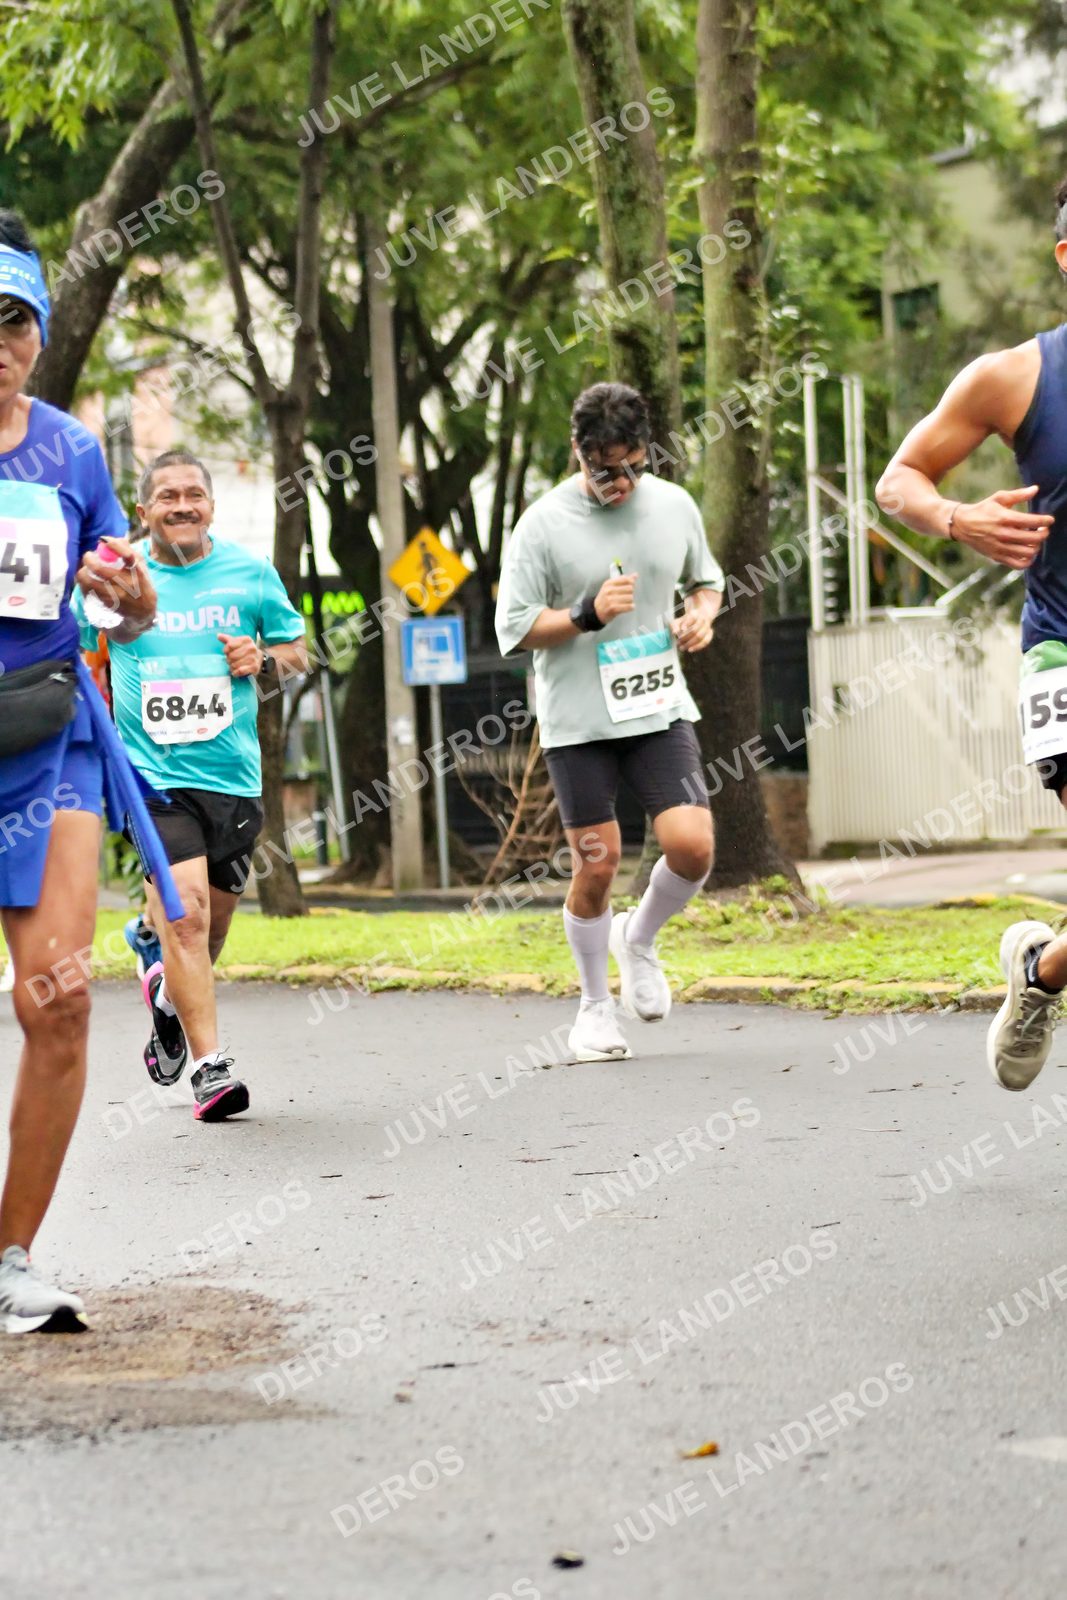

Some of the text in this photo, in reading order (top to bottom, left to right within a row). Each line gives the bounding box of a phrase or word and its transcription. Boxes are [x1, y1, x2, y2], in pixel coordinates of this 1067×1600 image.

[609, 665, 675, 701] 6255
[147, 693, 227, 722] 6844
[1021, 687, 1067, 736] 59
